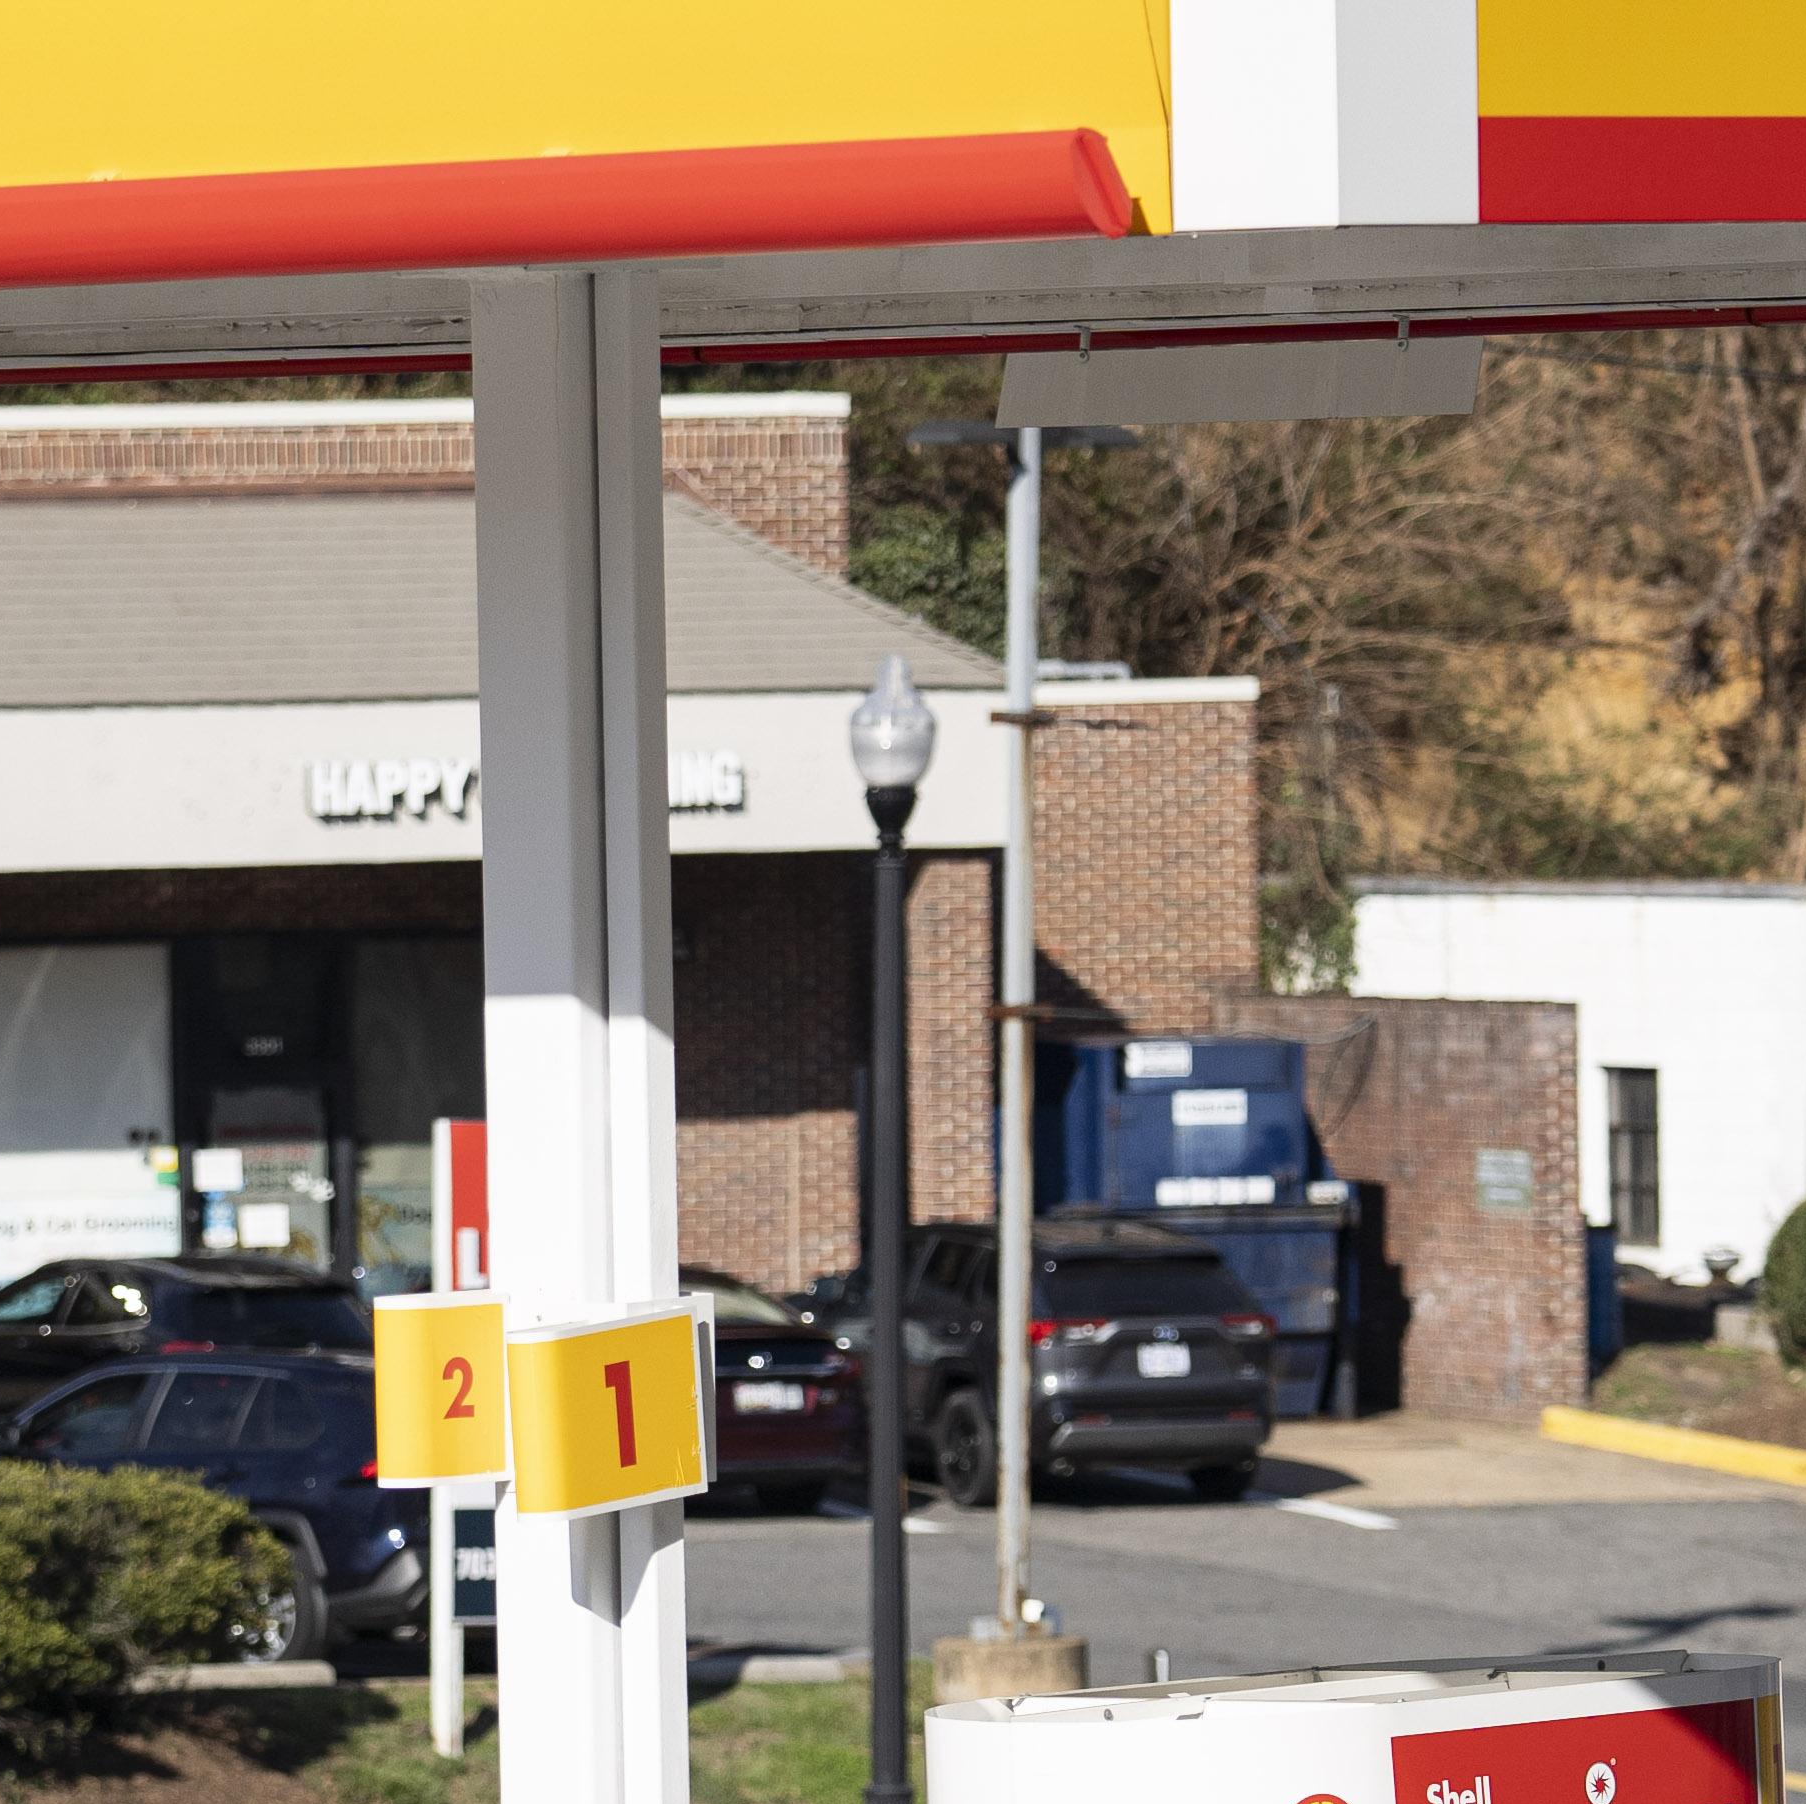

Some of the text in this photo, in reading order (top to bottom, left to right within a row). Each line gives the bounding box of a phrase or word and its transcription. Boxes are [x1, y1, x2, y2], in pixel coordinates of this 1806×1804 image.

[310, 757, 477, 818] HAPPY
[442, 1357, 475, 1419] 2
[604, 1360, 637, 1468] 1
